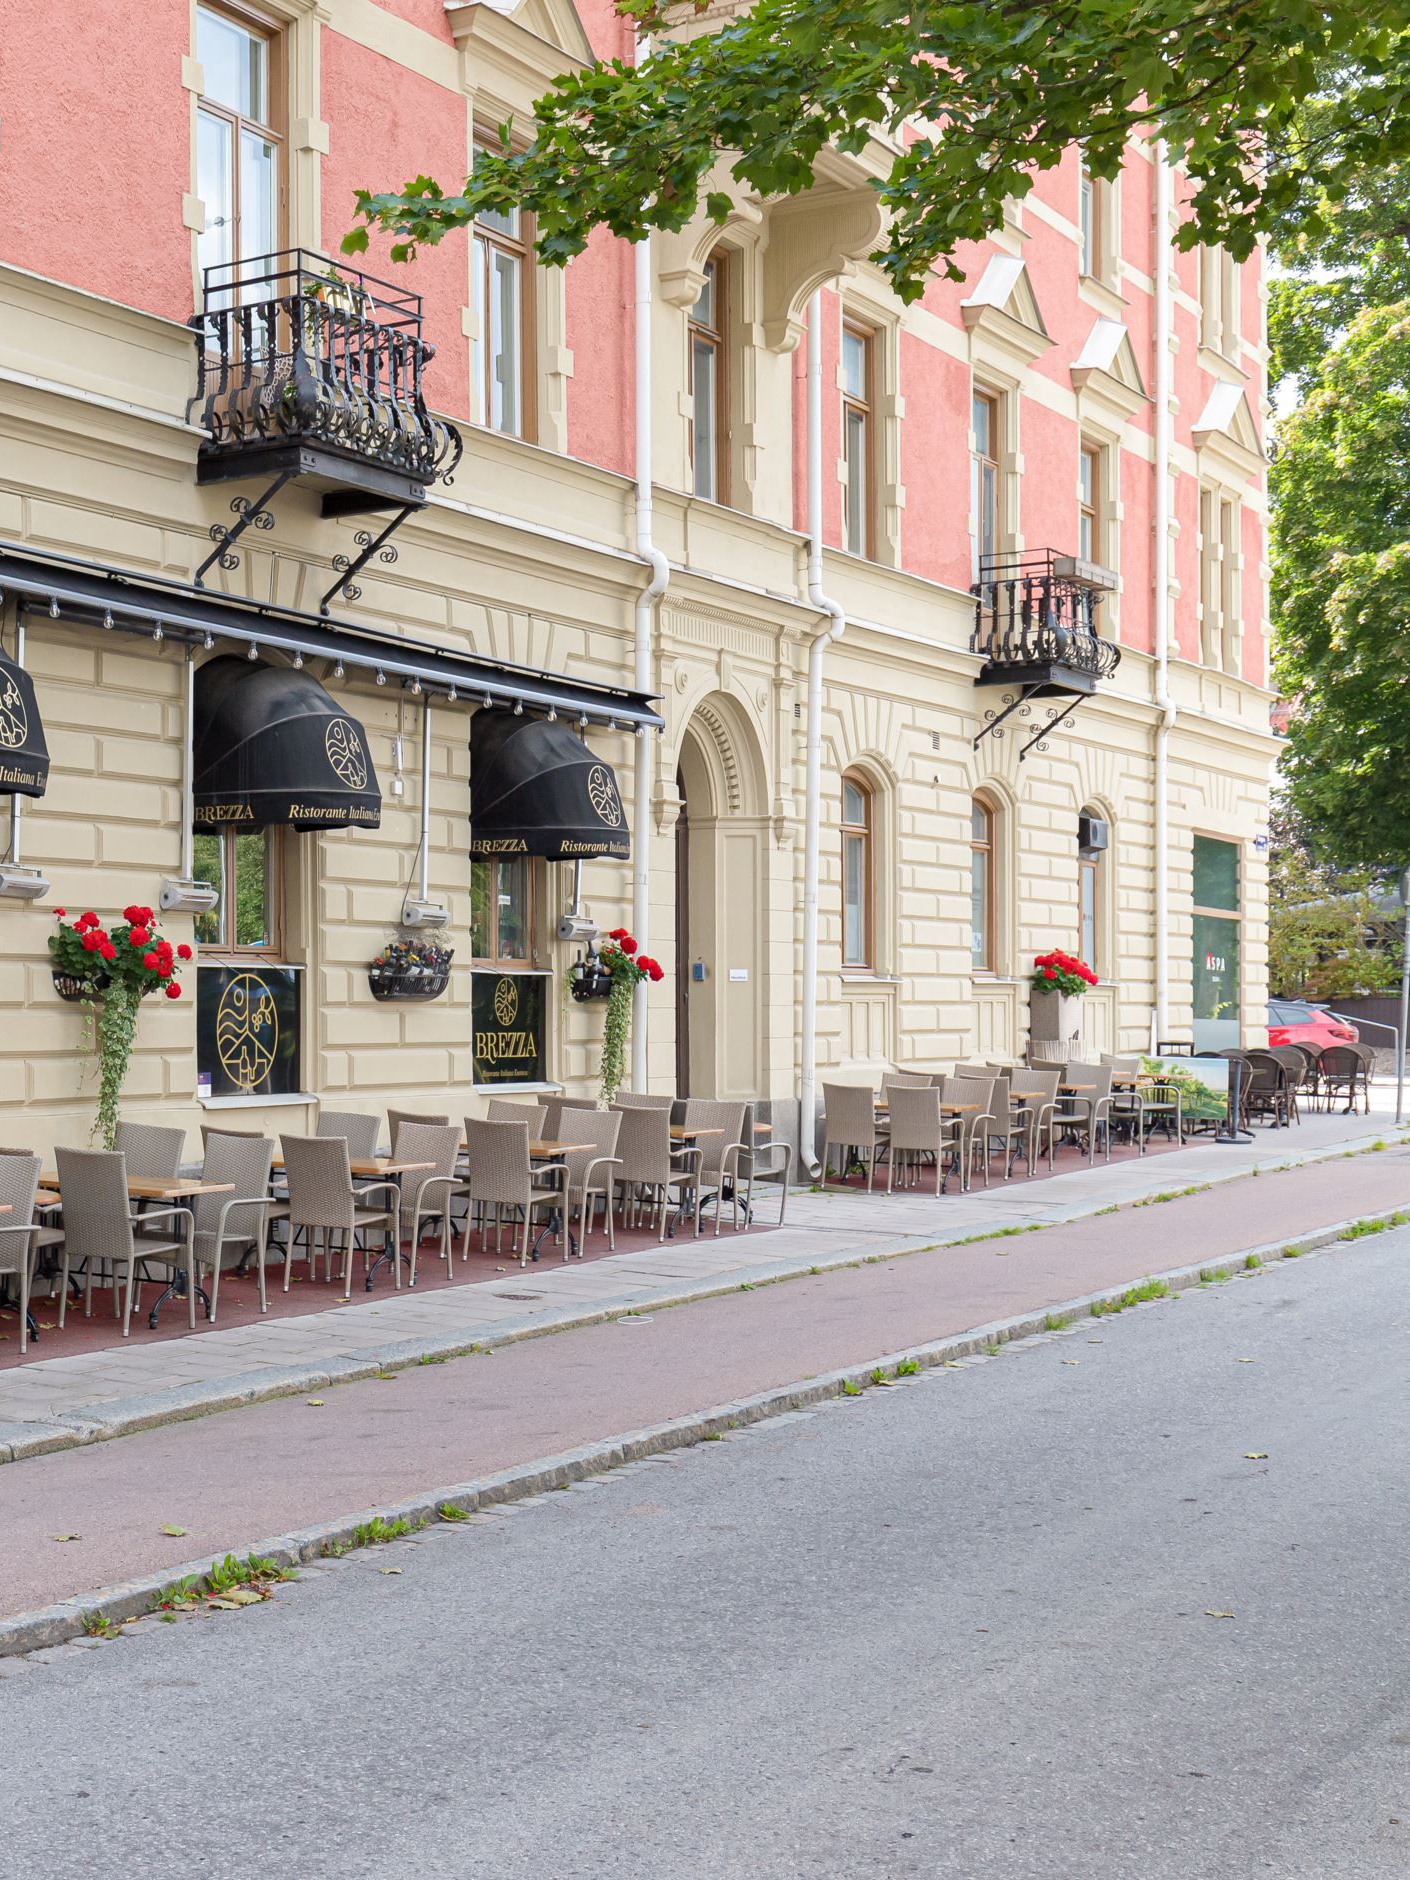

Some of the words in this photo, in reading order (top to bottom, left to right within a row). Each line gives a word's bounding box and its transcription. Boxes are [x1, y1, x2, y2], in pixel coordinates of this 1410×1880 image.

[195, 804, 254, 823] BREZZA
[288, 804, 347, 819] Ristorante
[472, 838, 529, 854] BREZZA
[560, 840, 608, 853] Ristorante
[475, 1032, 537, 1064] BREZZA
